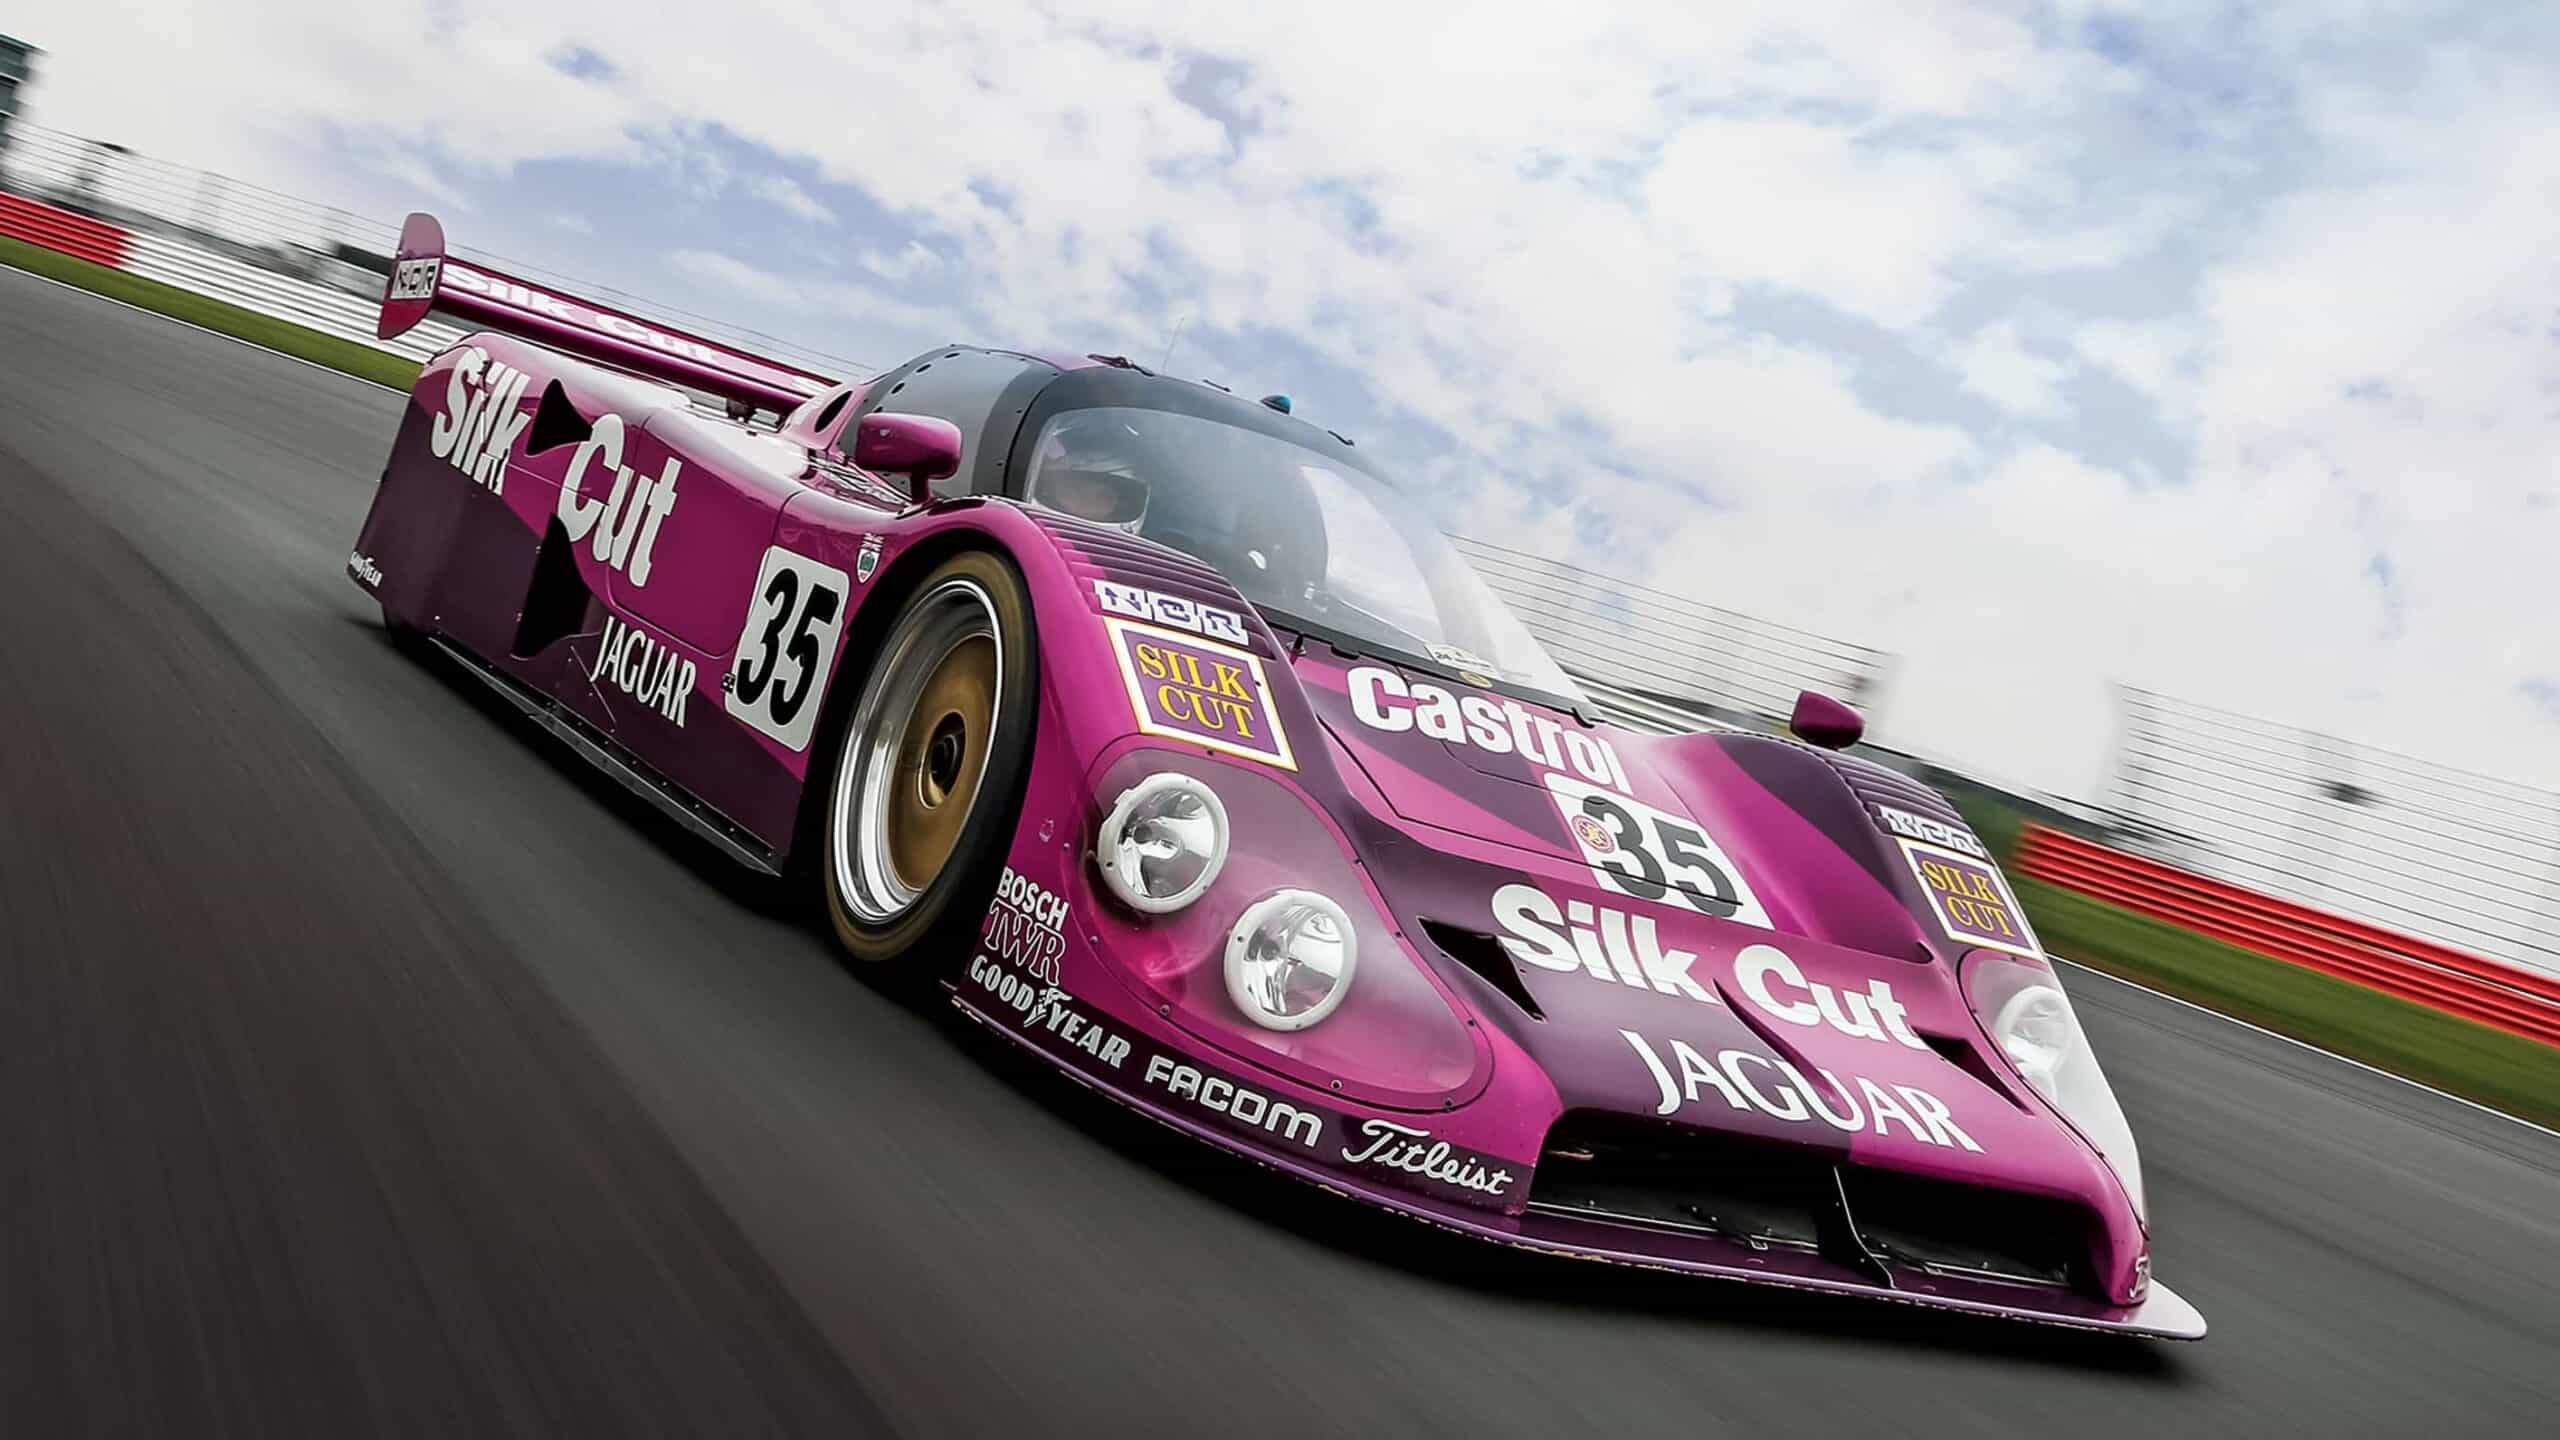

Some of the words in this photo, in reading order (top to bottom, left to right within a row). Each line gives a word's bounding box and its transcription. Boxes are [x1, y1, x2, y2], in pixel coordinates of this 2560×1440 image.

[441, 263, 577, 320] Silk
[594, 312, 720, 363] Cut
[431, 346, 530, 495] Silk
[557, 413, 682, 587] Cut
[736, 568, 840, 726] 35
[1102, 585, 1244, 641] NCR
[590, 615, 697, 729] JAGUAR
[1136, 643, 1254, 702] SILK
[1158, 685, 1255, 738] CUT
[1347, 667, 1633, 795] Castrol
[997, 866, 1069, 931] BOSCH
[1583, 795, 1737, 918] 35
[1921, 860, 2004, 905] SILK
[985, 897, 1066, 986] TWR
[1947, 895, 2015, 936] CUT
[1492, 884, 1723, 1006] Silk
[1734, 944, 1930, 1050] Cut
[1145, 1055, 1323, 1147] FACOM
[1618, 1028, 1985, 1154] JAGUAR
[1342, 1119, 1513, 1194] Titleist
